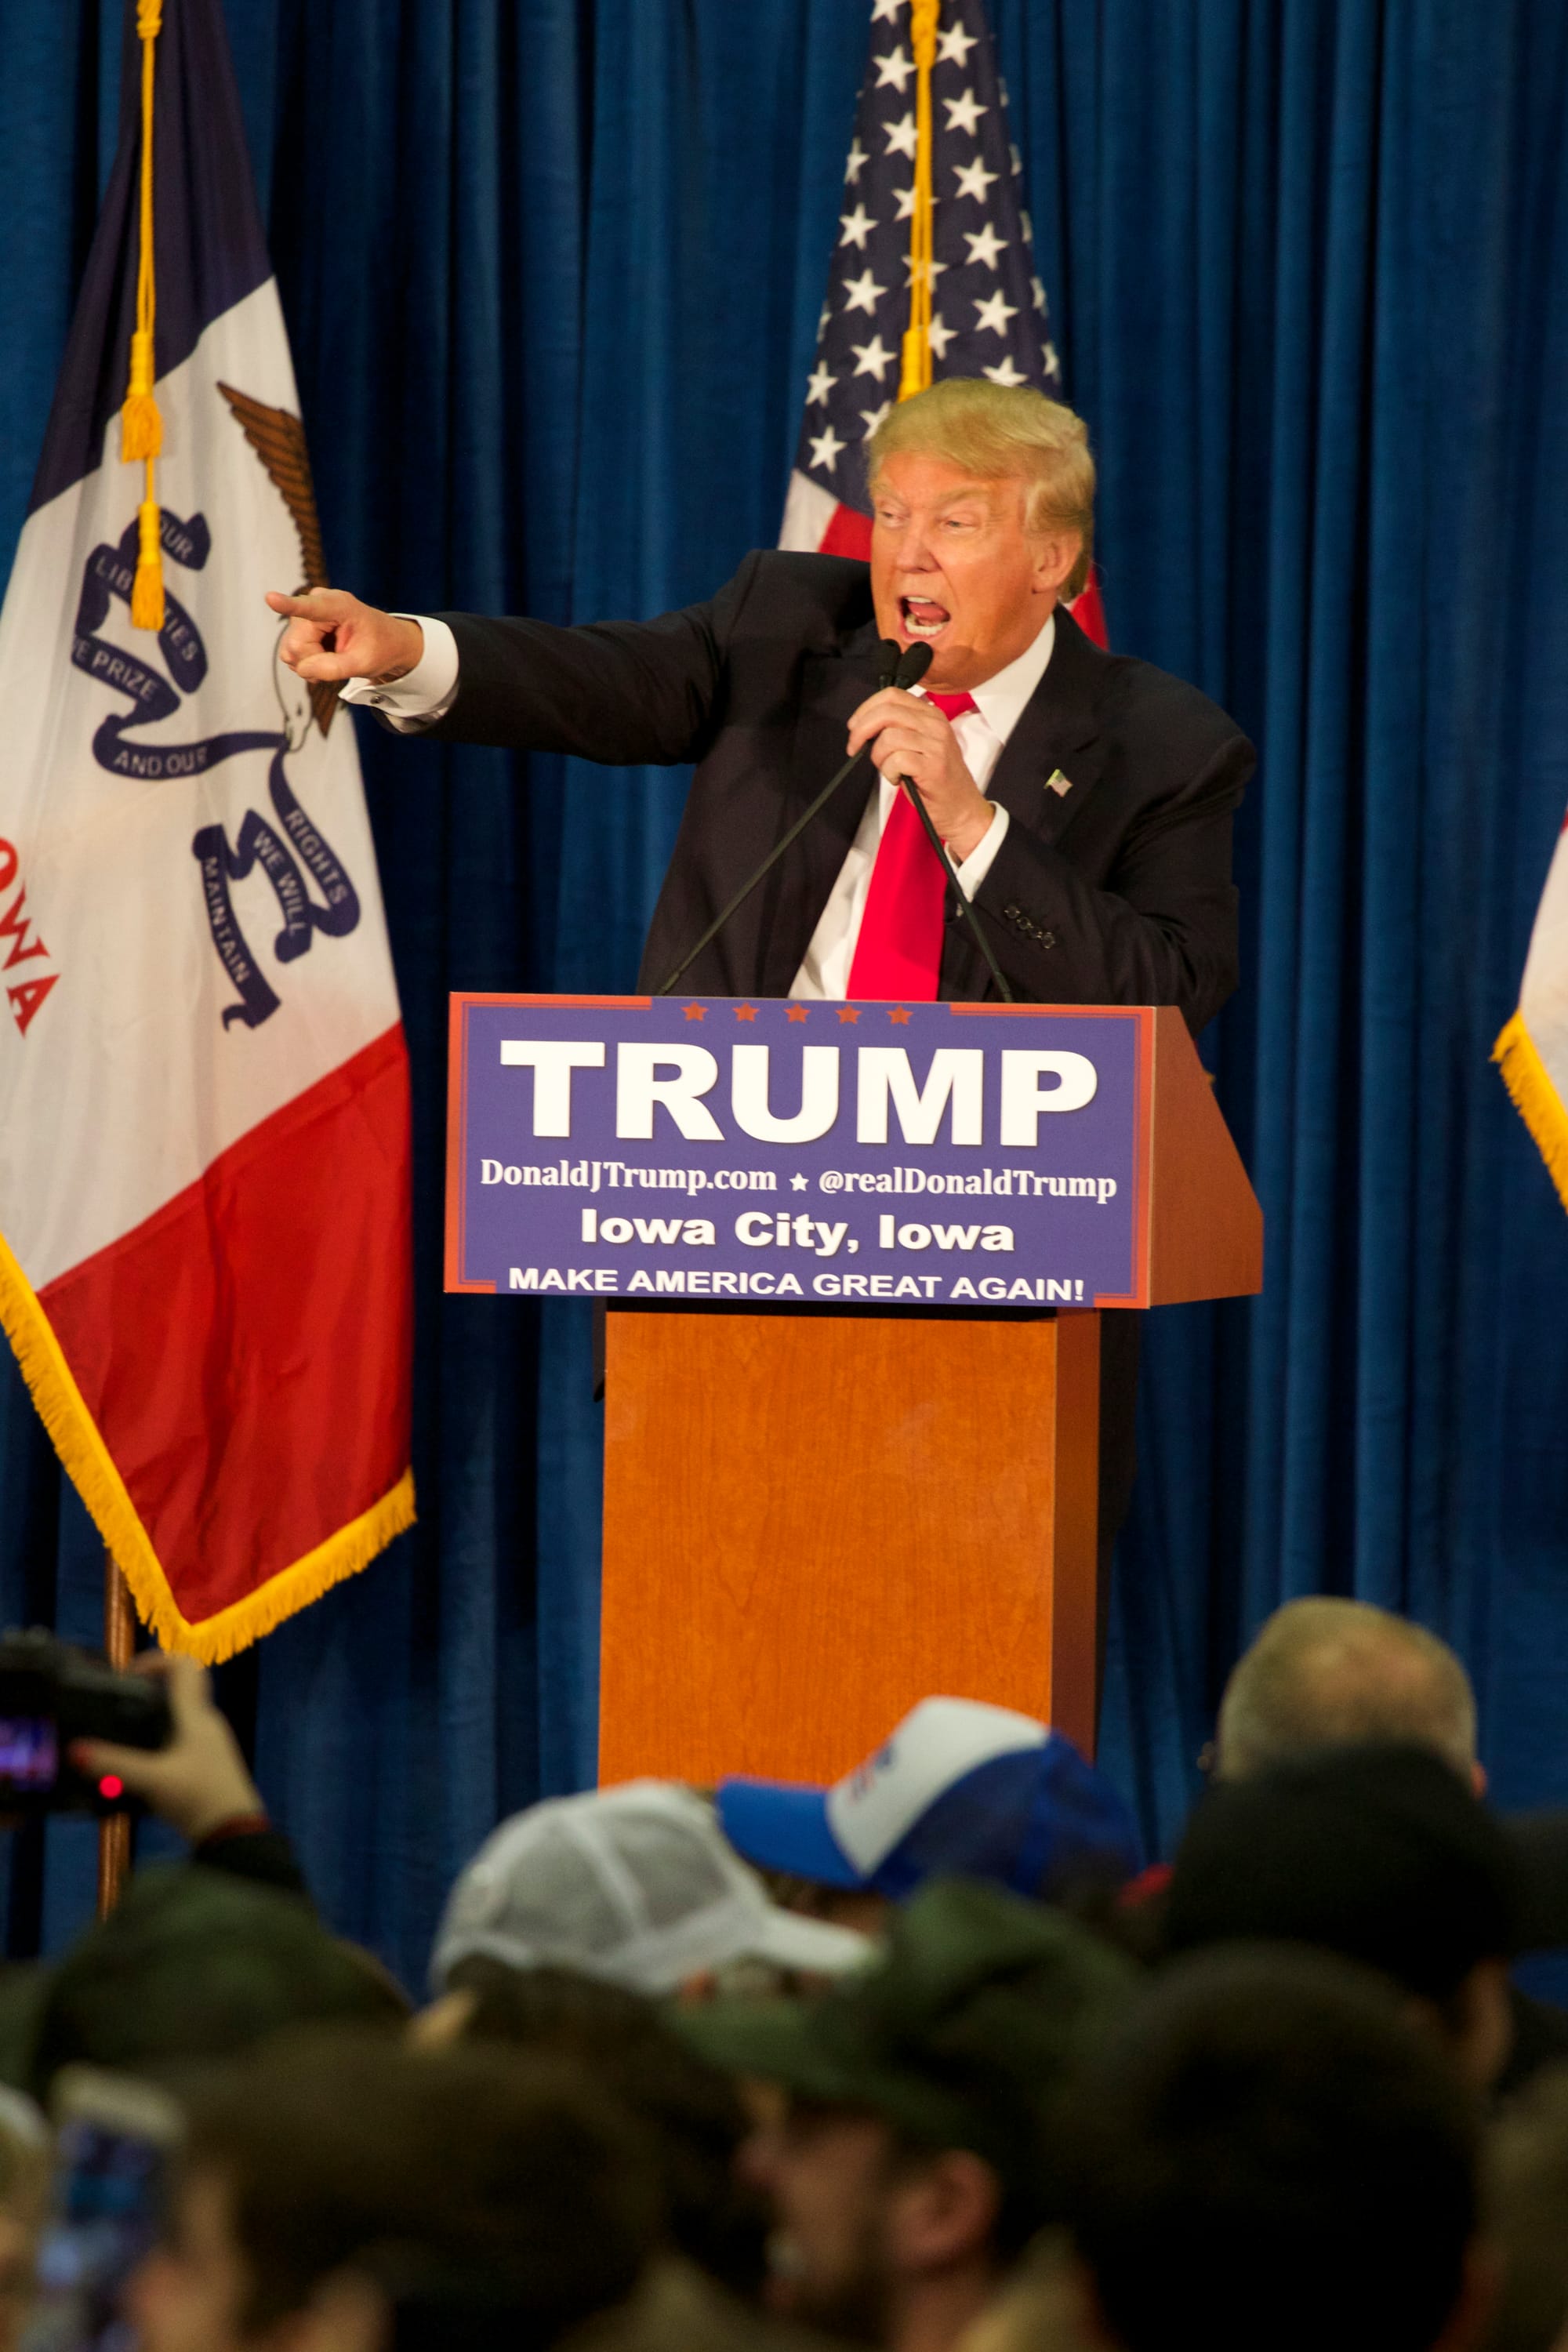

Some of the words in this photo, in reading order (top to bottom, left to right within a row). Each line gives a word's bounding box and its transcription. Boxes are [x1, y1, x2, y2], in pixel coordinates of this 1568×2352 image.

[91, 649, 158, 702] PRIZE
[114, 750, 162, 777] AND
[166, 746, 207, 775] OUR
[285, 808, 348, 905] RIGHTS
[252, 829, 285, 873] WE
[277, 871, 307, 938] WILL
[205, 856, 252, 984] MAINTAIN
[499, 1040, 1098, 1147] TRUMP
[480, 1158, 778, 1196] DonaldJTrump.com
[818, 1166, 1118, 1205] @realDonaldTrump
[581, 1207, 717, 1246] Iowa
[734, 1210, 859, 1258] City,
[878, 1214, 1015, 1252] Iowa
[508, 1266, 619, 1292] MAKE
[626, 1269, 805, 1296] AMERICA
[811, 1272, 943, 1299] GREAT
[949, 1276, 1085, 1302] AGAIN!
